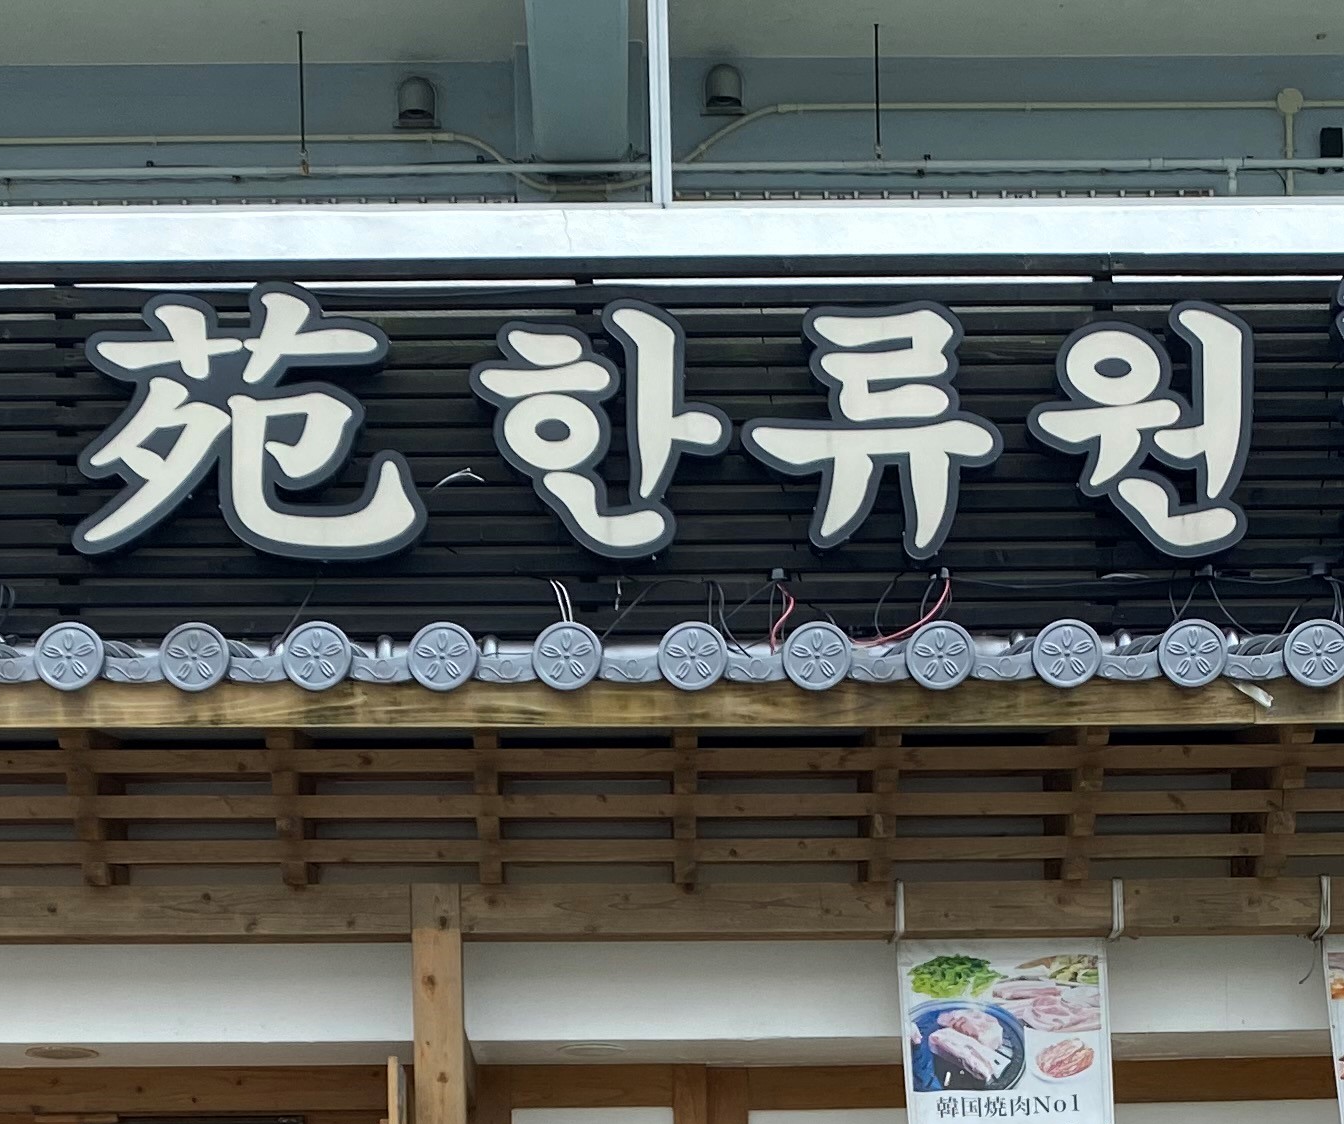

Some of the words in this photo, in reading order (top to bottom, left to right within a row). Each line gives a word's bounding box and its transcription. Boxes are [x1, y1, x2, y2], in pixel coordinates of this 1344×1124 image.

[476, 304, 1246, 552] 한류원
[935, 1093, 1081, 1119] 韓国焼肉No1
